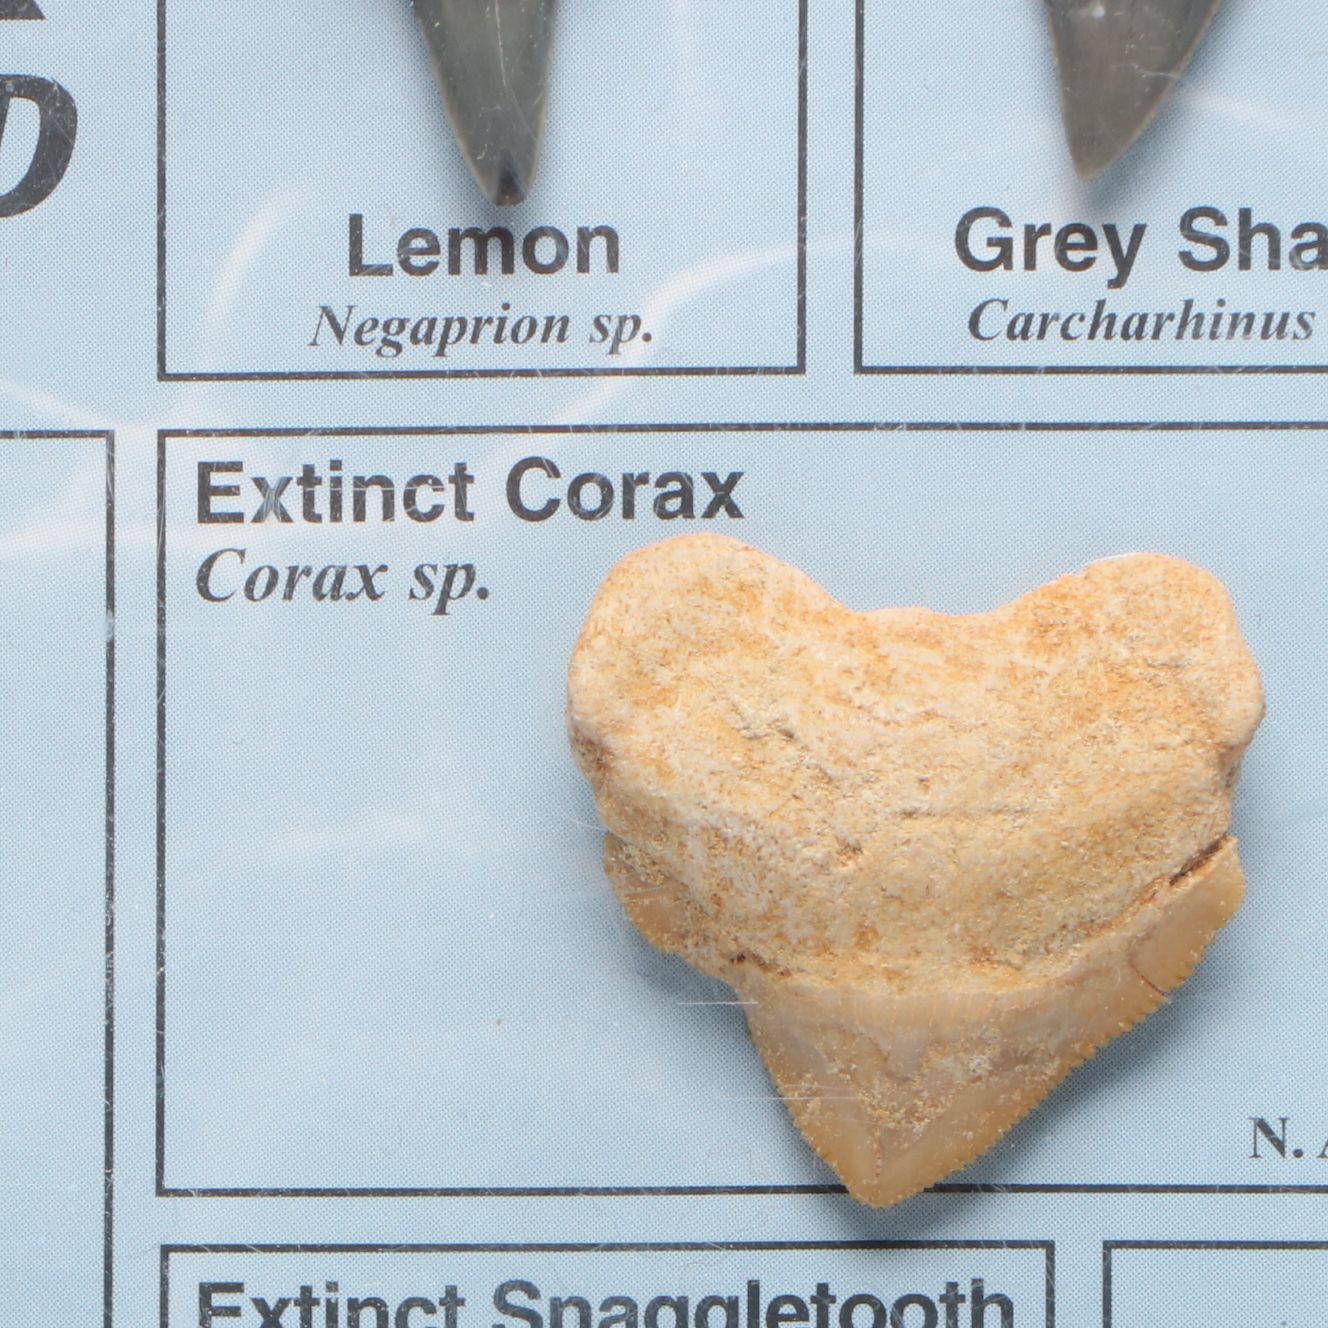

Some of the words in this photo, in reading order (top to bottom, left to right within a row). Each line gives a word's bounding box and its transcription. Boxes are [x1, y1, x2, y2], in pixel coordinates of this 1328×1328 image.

[348, 213, 620, 277] Lemon
[954, 205, 1148, 290] Grey
[307, 302, 570, 358] Negaprion
[588, 312, 653, 355] sp.
[967, 298, 1317, 341] Carcharhinus
[197, 459, 475, 525] Extinct
[505, 456, 745, 522] Corax
[195, 550, 389, 603] Corax
[407, 562, 490, 615] sp.
[1248, 1116, 1304, 1159] N.
